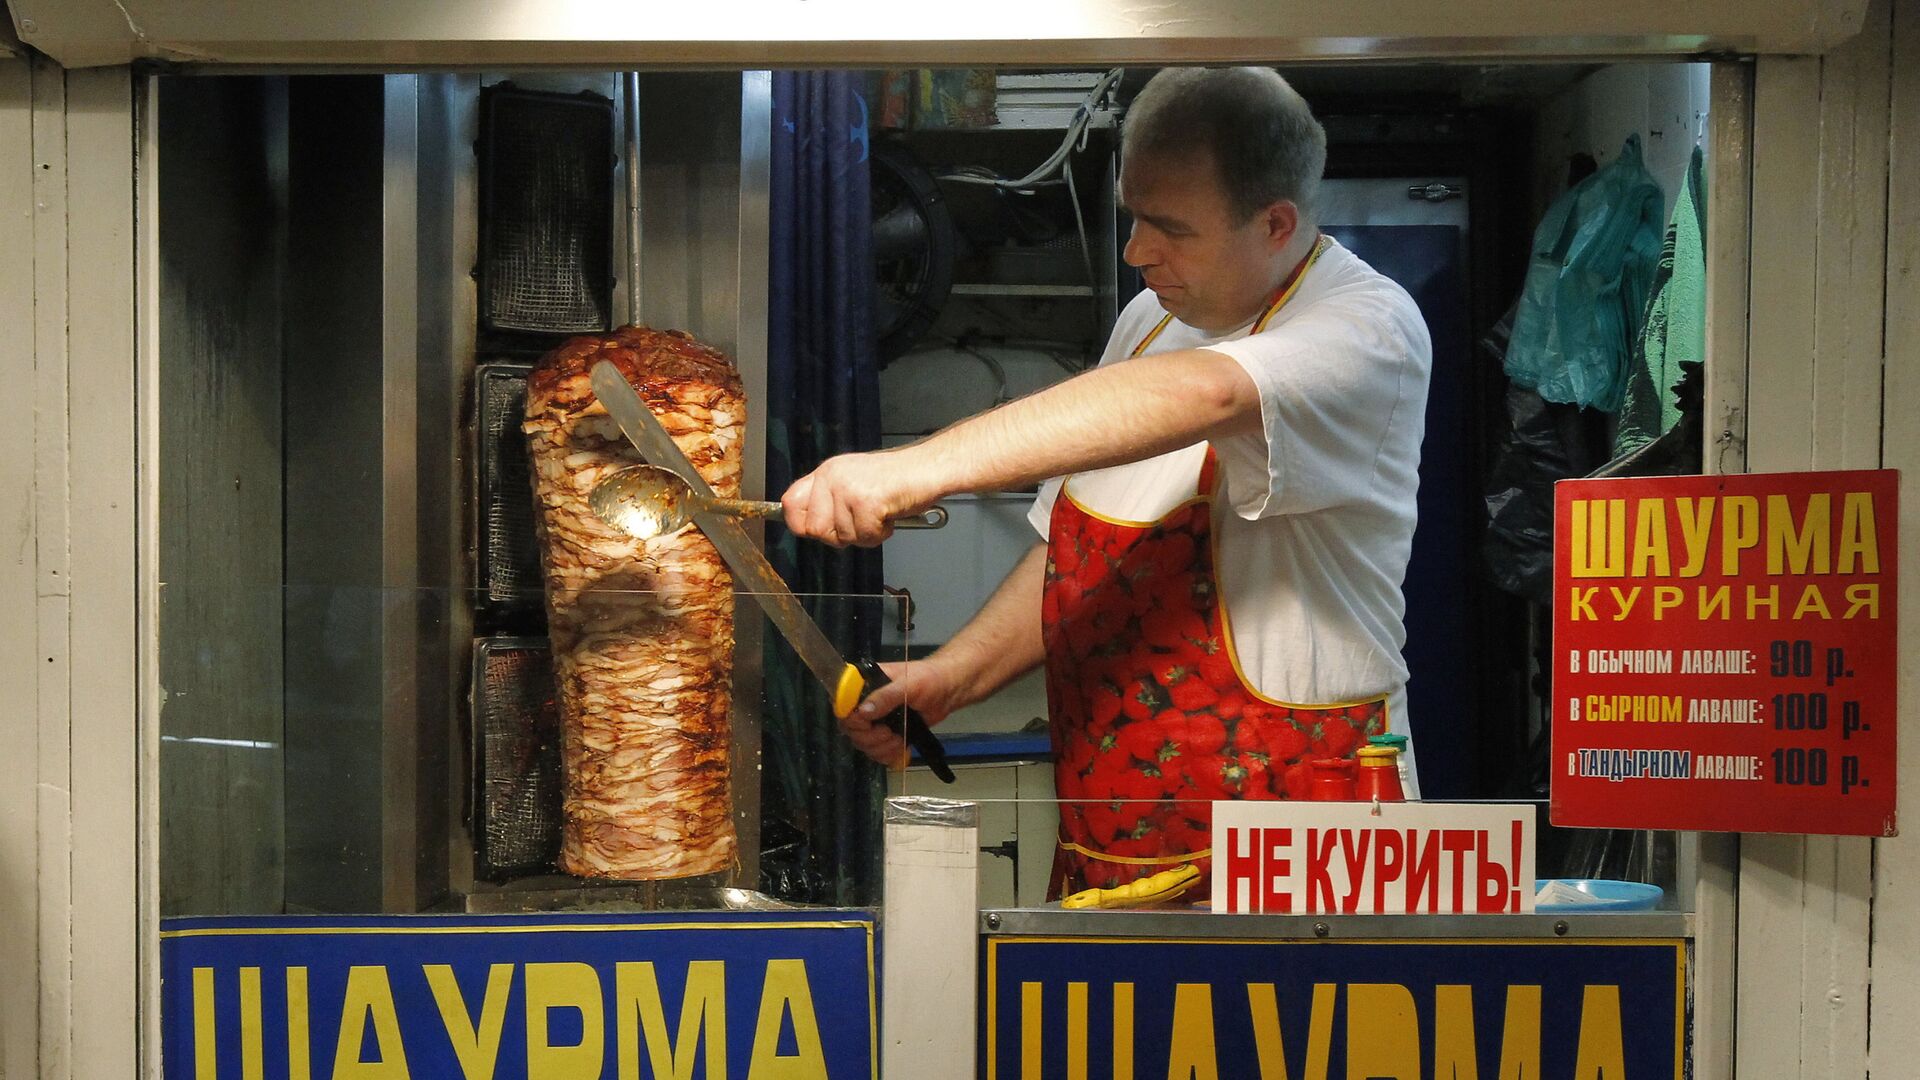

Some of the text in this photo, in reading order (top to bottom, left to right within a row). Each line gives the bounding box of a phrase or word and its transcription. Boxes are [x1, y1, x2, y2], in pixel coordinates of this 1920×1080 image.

[1571, 492, 1880, 578] ШАУРМА
[1570, 583, 1880, 621] КУРИНАЯ
[1588, 650, 1672, 673] ОБЫЧНОМ
[1680, 650, 1756, 674] ЛАВАШЕ:
[1771, 640, 1812, 677] 90
[1827, 647, 1854, 686] р.
[1586, 695, 1682, 722] СЫРНОМ
[1687, 699, 1764, 723] ЛАВАШЕ:
[1772, 693, 1827, 730] 100
[1843, 701, 1870, 740] р.
[1578, 748, 1691, 782] ТАНДЫРНОМ
[1694, 755, 1763, 780] ЛАВАШЕ:
[1771, 748, 1827, 785] 100
[1841, 756, 1869, 795] р.
[1227, 820, 1522, 914] НЕ КУРИТЬ!
